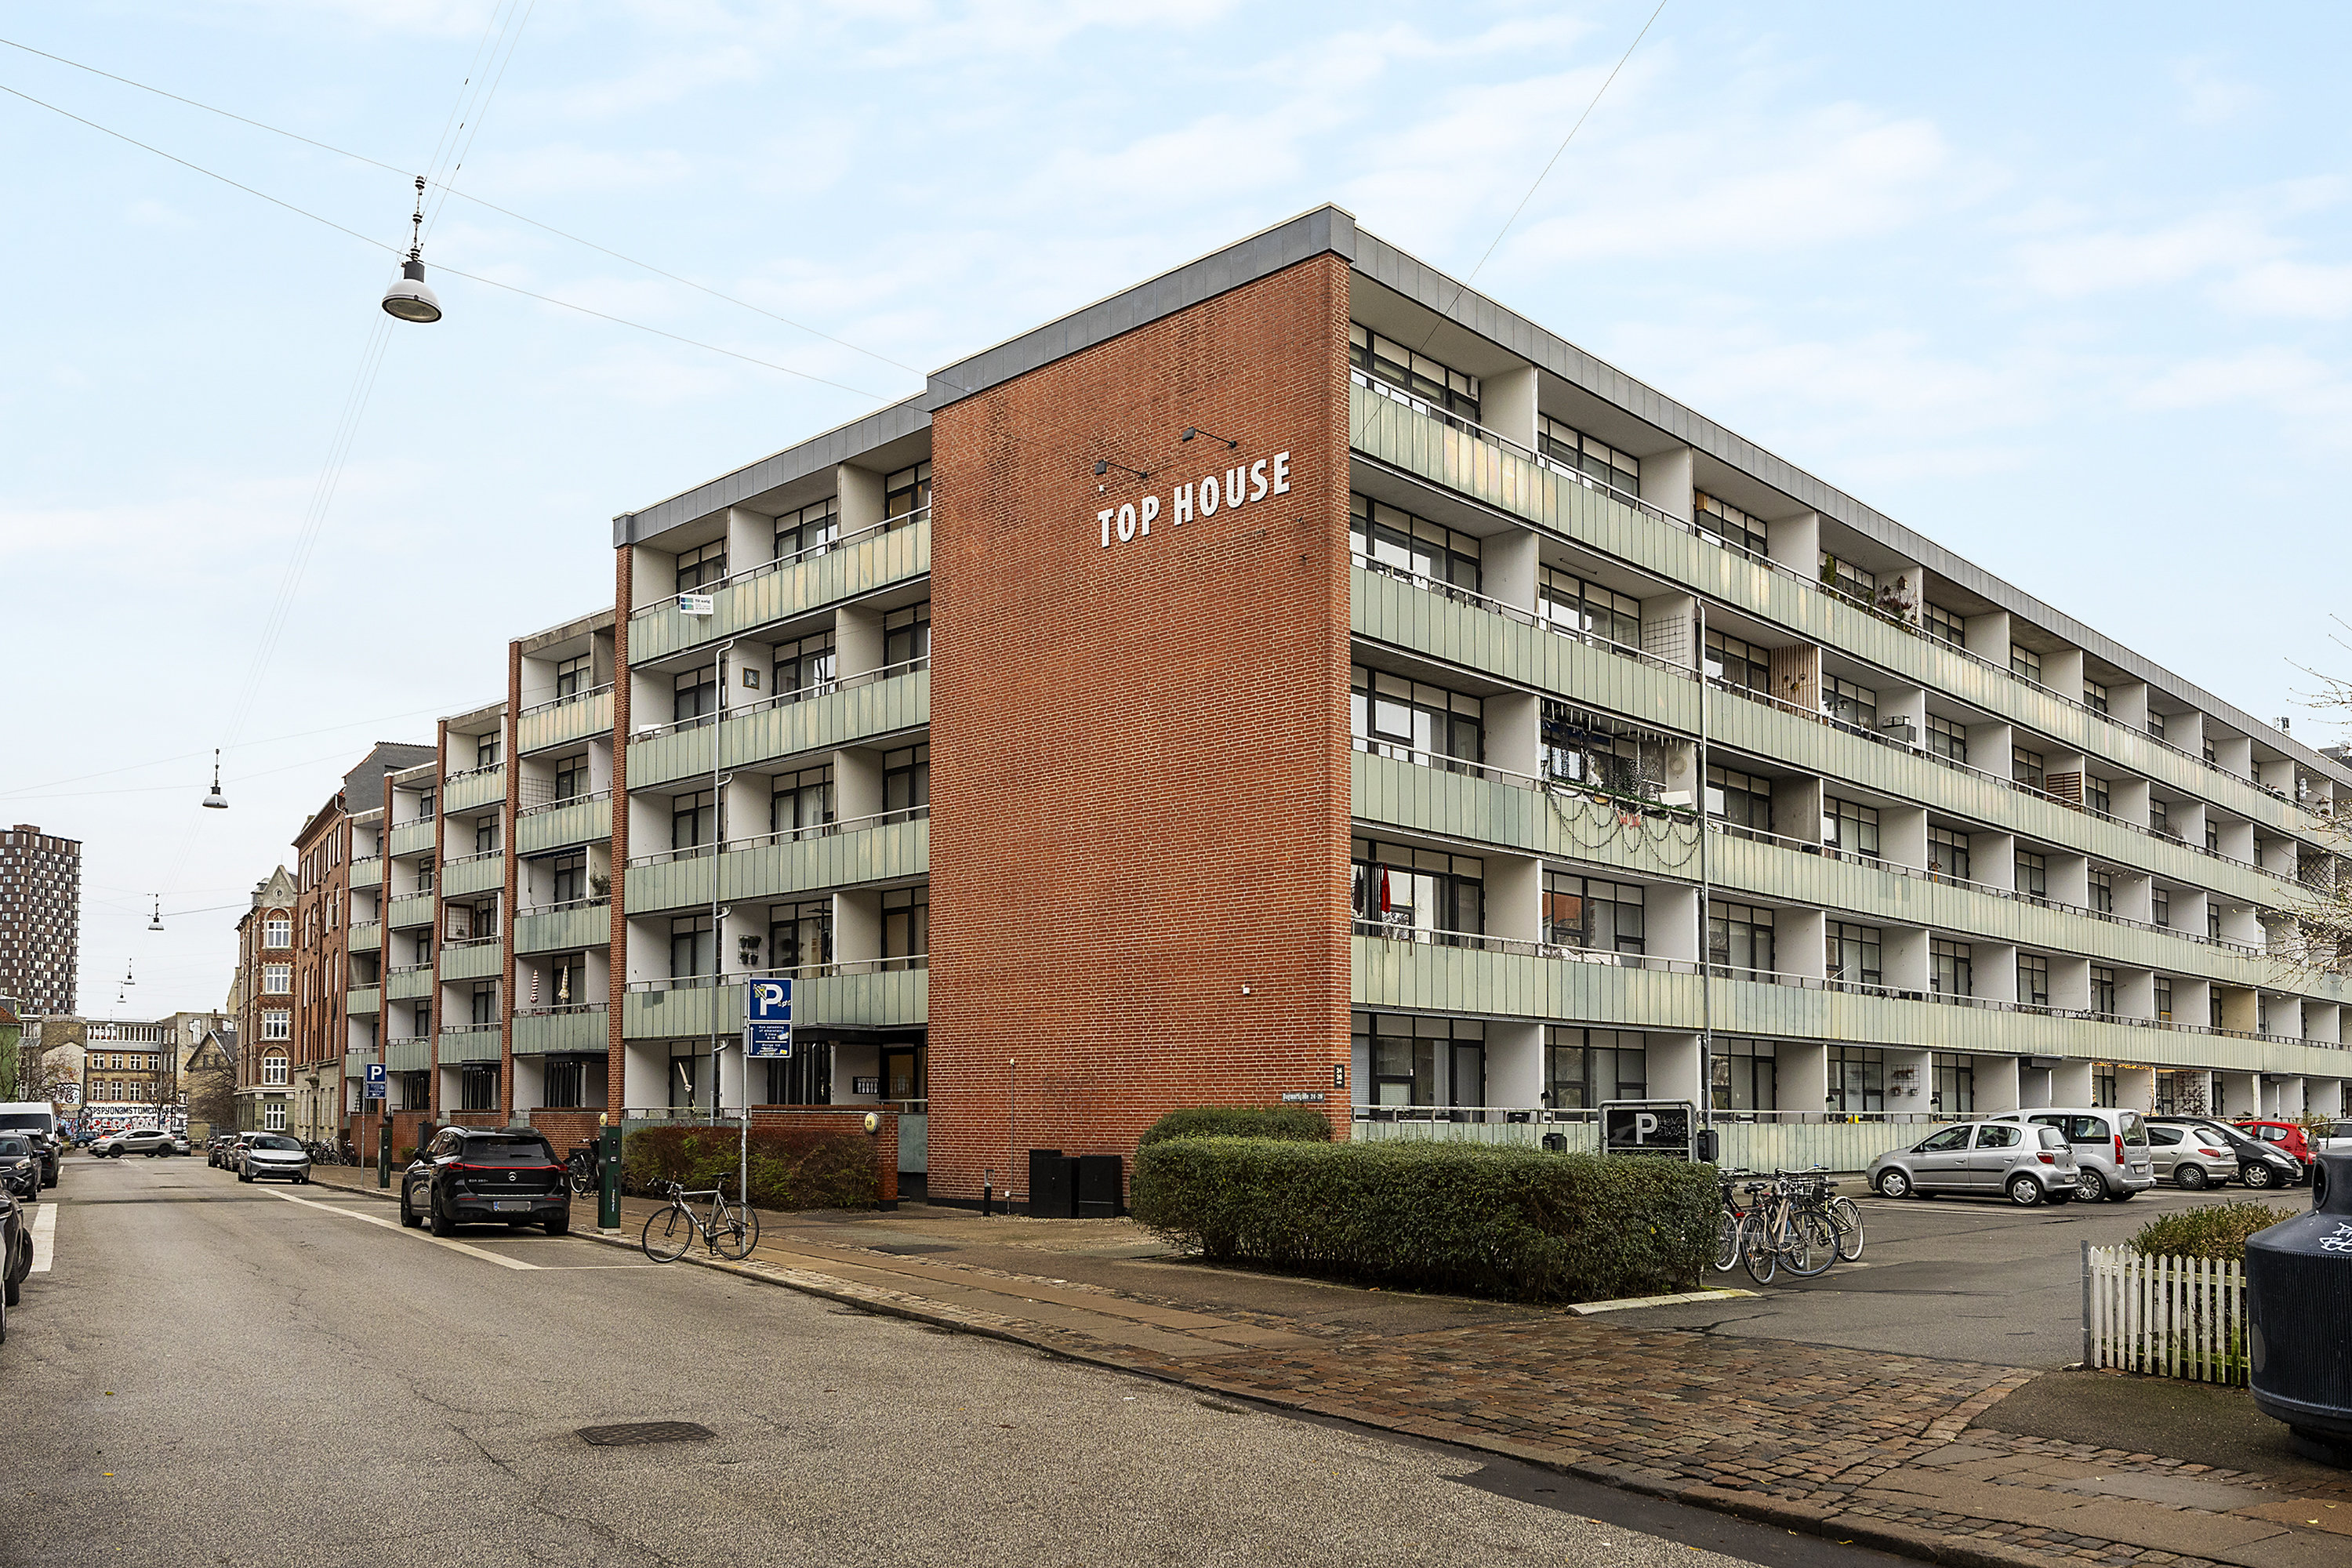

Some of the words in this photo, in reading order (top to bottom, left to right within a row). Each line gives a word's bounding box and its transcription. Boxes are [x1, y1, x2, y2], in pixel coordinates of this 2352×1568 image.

[1098, 495, 1160, 548] TOP
[1174, 451, 1291, 526] HOUSE
[760, 984, 783, 1016] P
[371, 1065, 383, 1080] P
[1635, 1113, 1658, 1145] P
